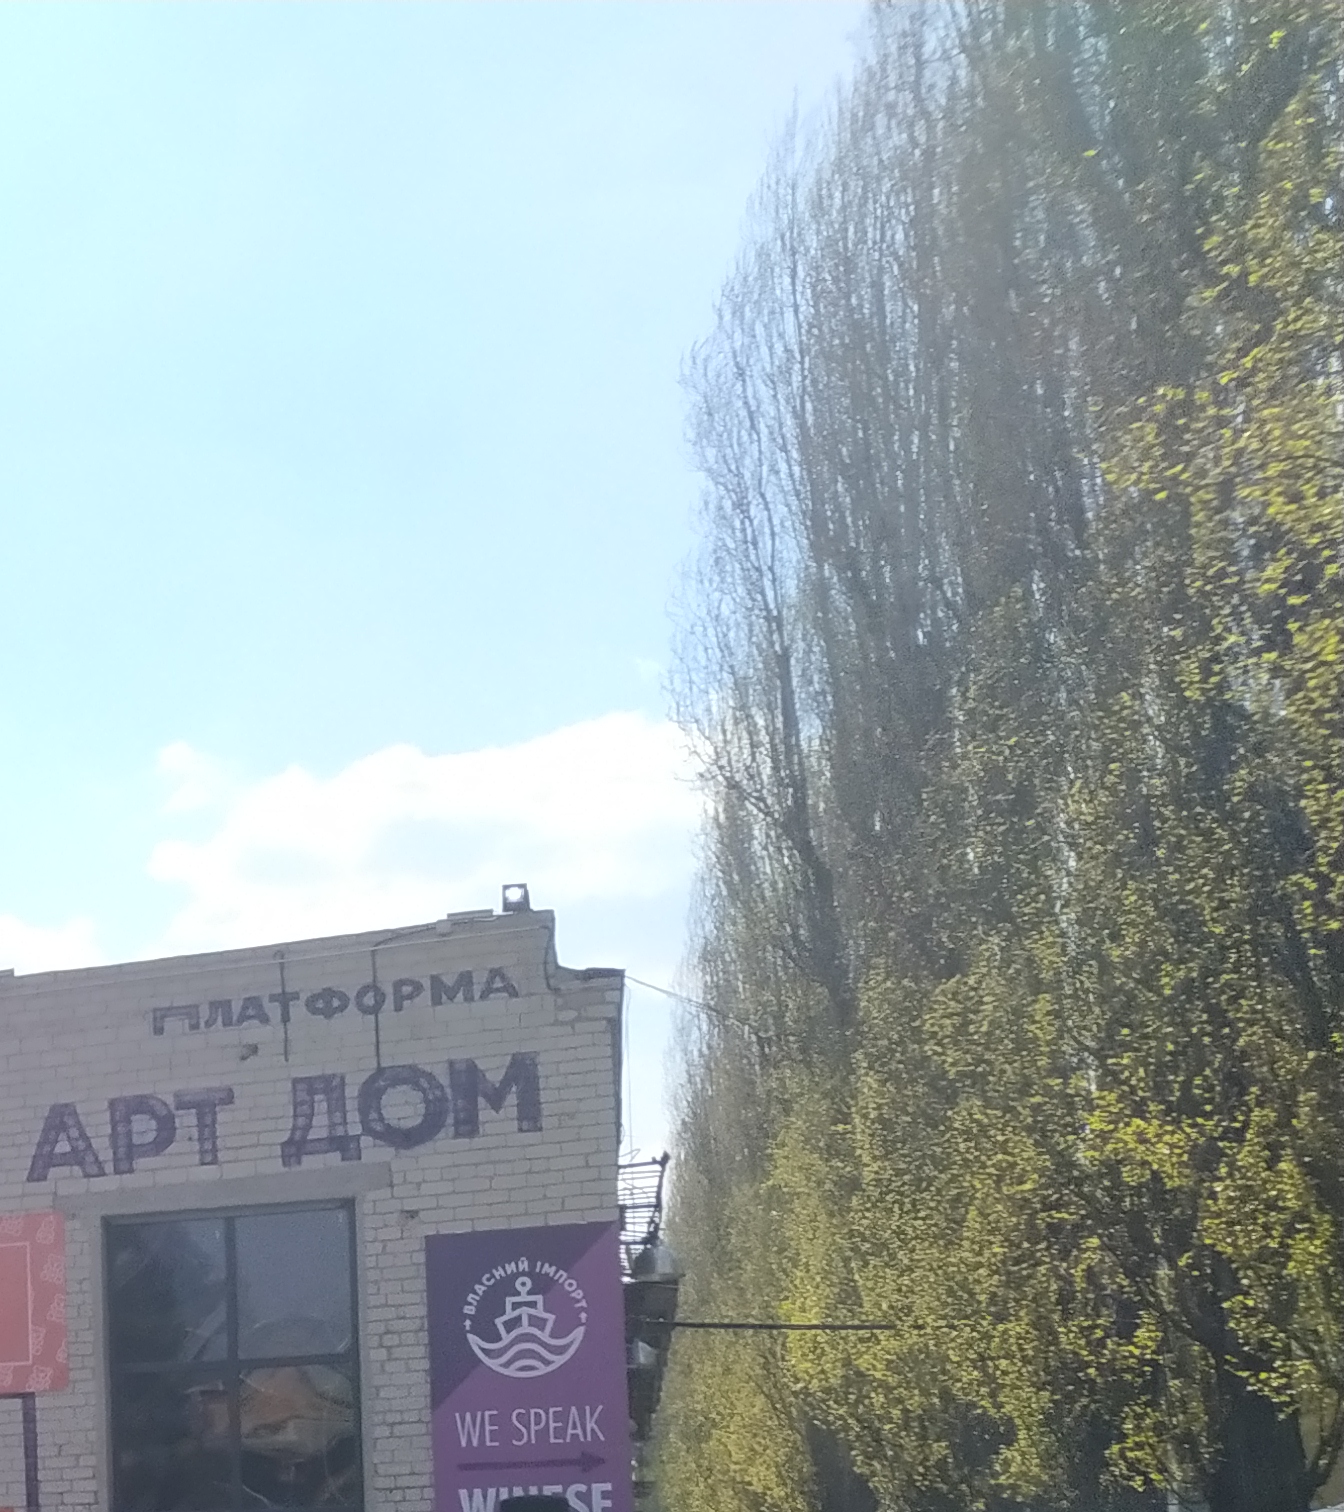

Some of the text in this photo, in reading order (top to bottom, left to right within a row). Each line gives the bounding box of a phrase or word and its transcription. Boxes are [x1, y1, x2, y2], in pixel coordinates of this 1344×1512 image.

[152, 966, 520, 1036] ПЛАТФОРМА
[26, 1051, 544, 1183] АРТ ДОМ
[463, 1257, 529, 1315] ВЛАСНИЙ
[455, 1405, 605, 1448] WE SPEAK
